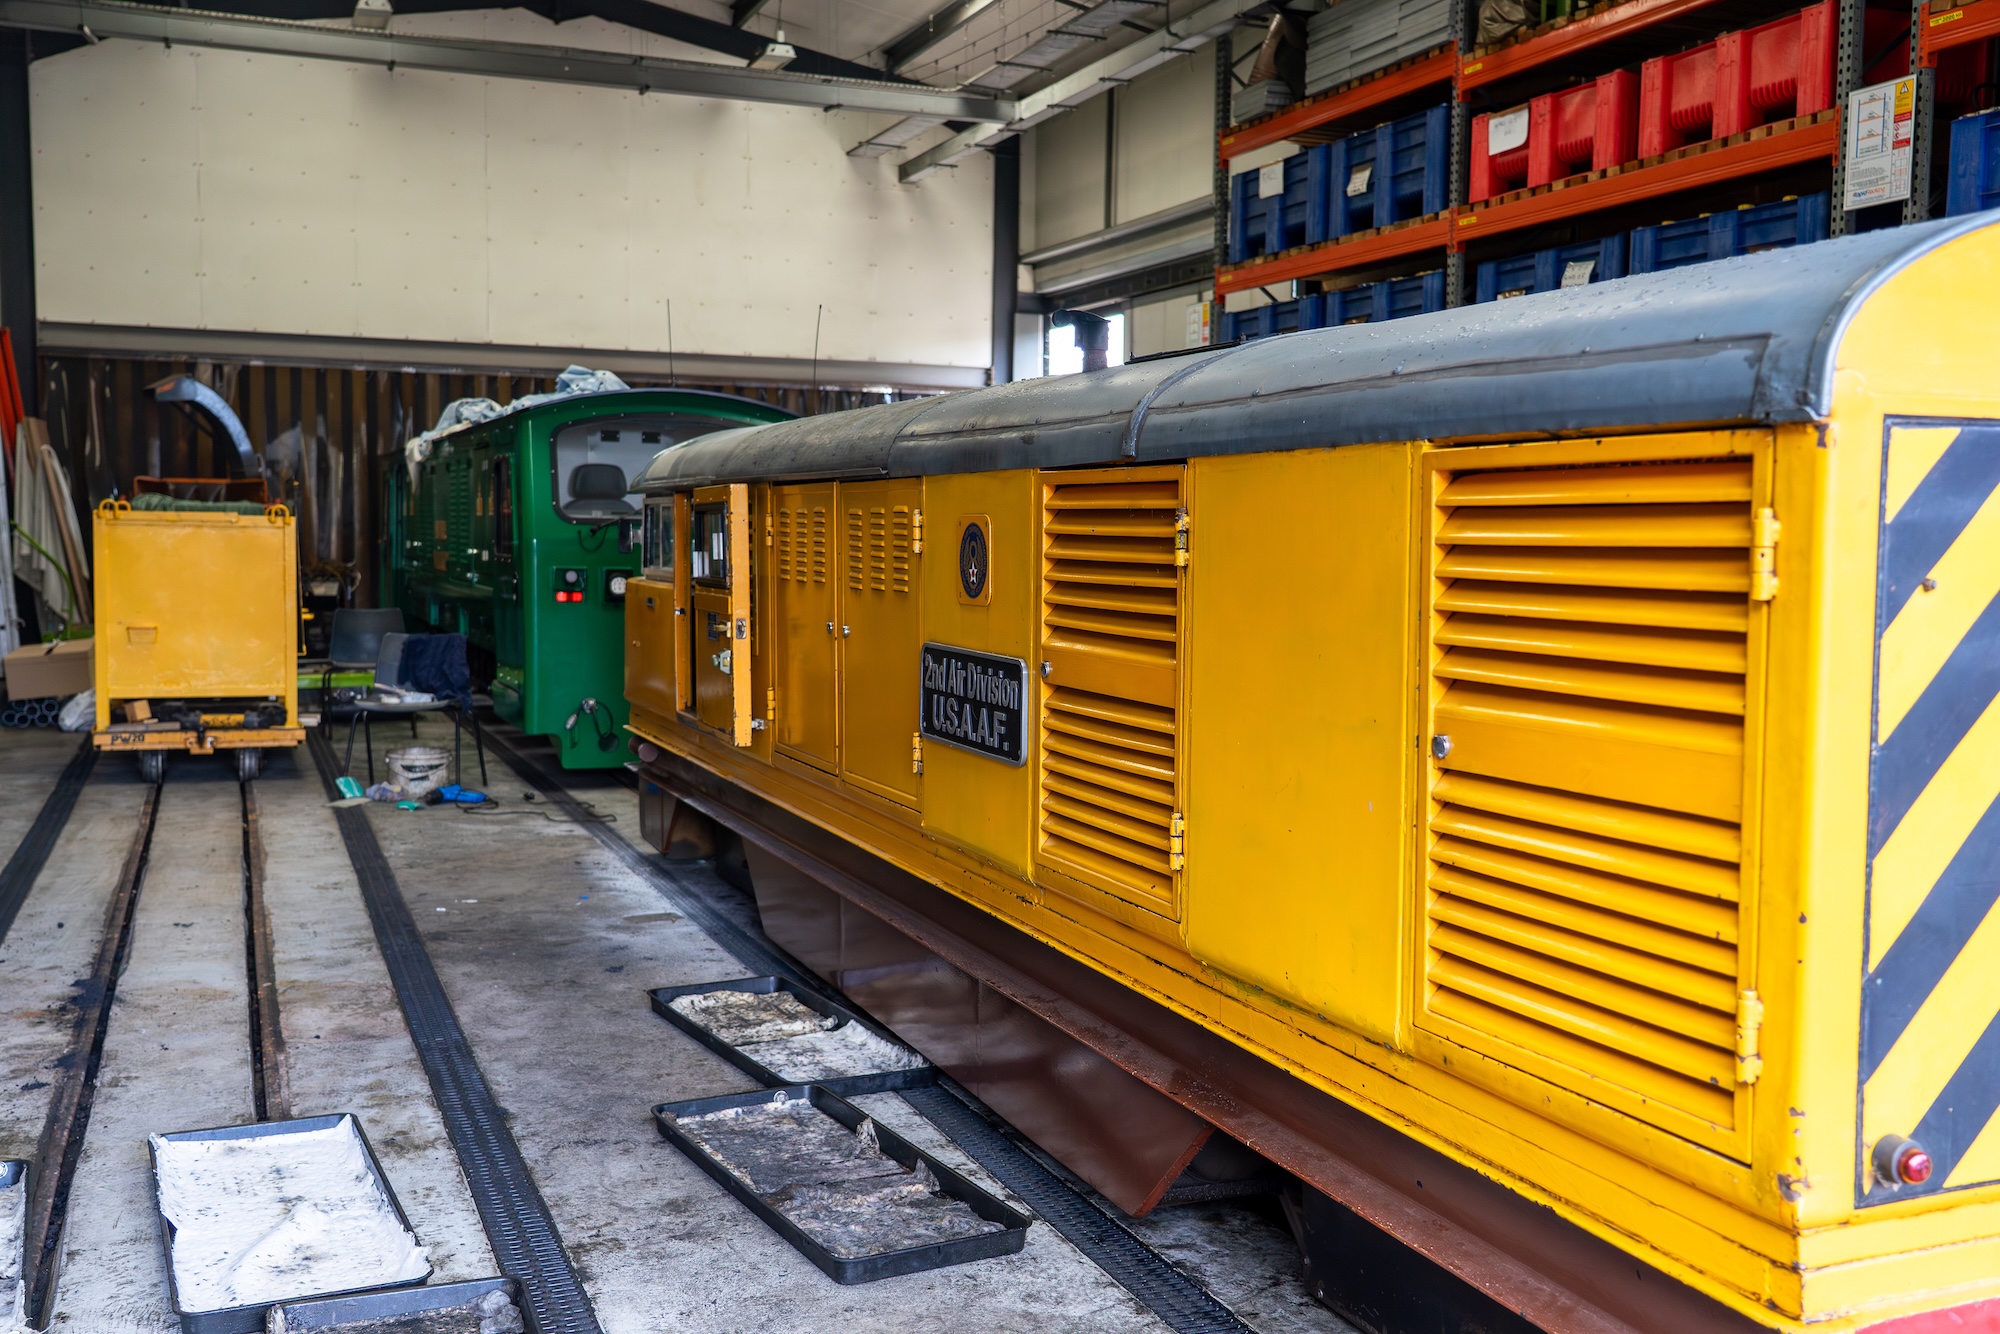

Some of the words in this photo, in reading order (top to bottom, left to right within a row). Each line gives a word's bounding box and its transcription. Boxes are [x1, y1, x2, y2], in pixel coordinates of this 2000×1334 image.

[924, 653, 948, 692] 2nd
[947, 658, 966, 697] Air
[966, 662, 1019, 711] Division
[111, 733, 145, 745] PW20
[932, 694, 1010, 752] U.S.A.A.F.
